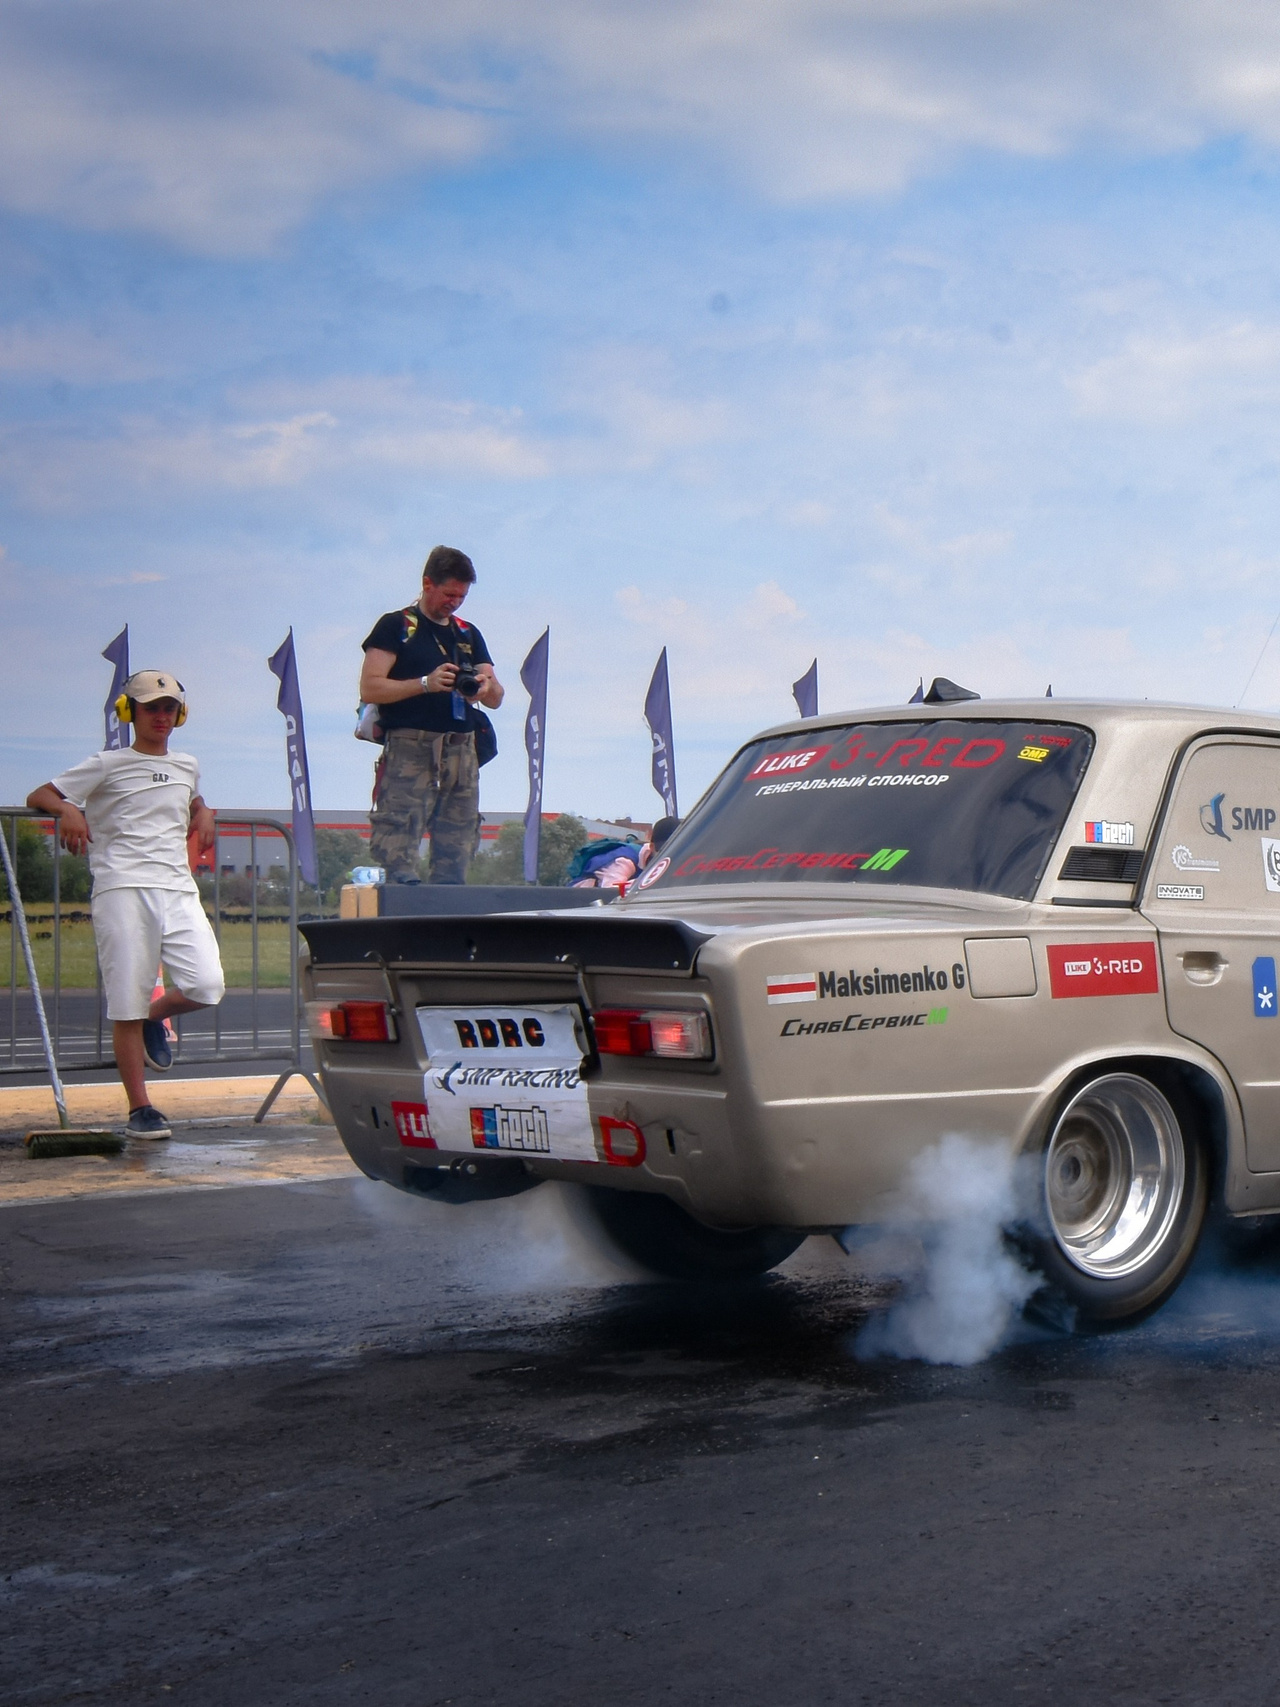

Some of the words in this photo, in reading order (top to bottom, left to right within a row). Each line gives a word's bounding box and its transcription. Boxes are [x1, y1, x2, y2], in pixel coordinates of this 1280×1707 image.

[753, 758, 764, 774] I
[764, 751, 817, 772] LIKE
[1020, 747, 1048, 759] OMP
[152, 772, 170, 783] GAP
[755, 774, 867, 796] ГЕНЕРАЛЬНЫЙ
[867, 774, 949, 786] СПОНСОР
[1231, 806, 1276, 831] SMP
[818, 965, 948, 999] Maksimenko
[951, 963, 965, 989] G
[454, 1018, 545, 1048] RDRC
[457, 1068, 502, 1086] SMP
[501, 1069, 582, 1089] RACING
